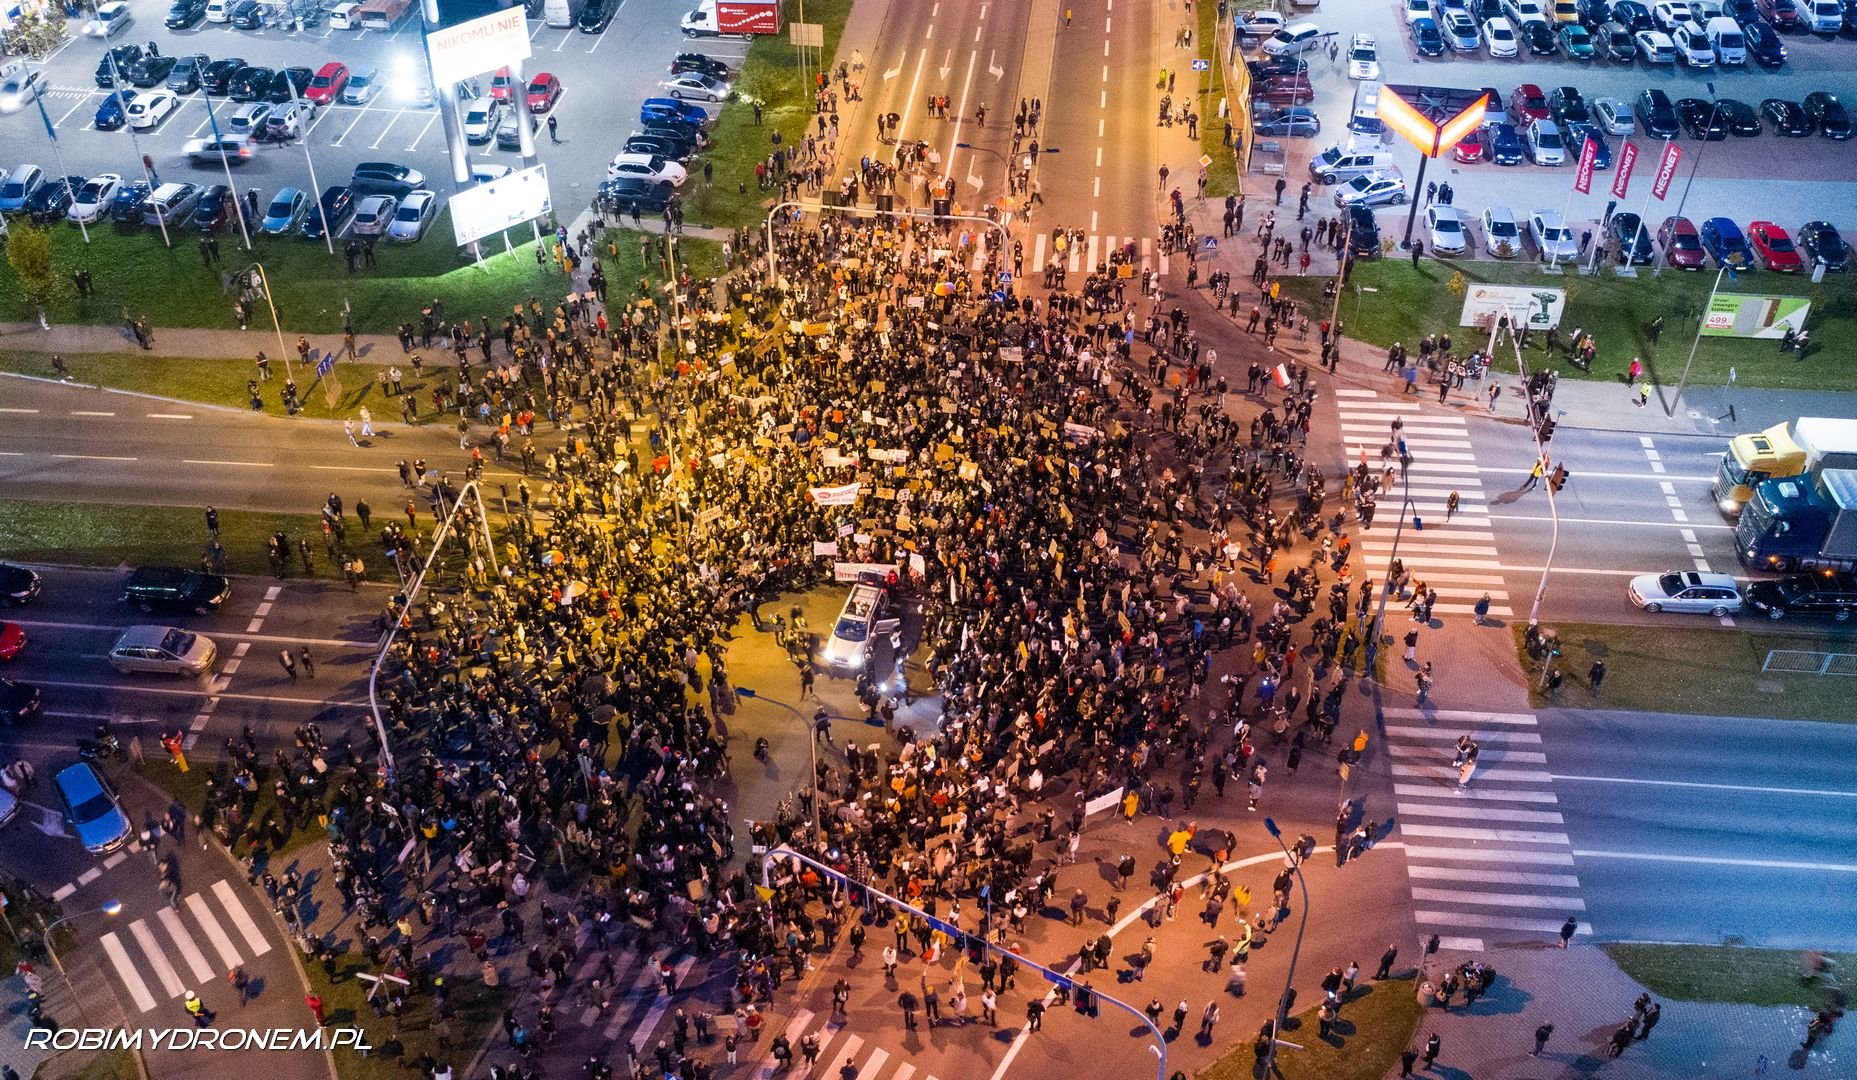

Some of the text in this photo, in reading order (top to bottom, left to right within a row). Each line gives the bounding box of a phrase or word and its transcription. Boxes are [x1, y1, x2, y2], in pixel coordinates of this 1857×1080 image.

[437, 16, 520, 50] NIKOMU NIE
[1578, 143, 1594, 190] NEONET
[1615, 146, 1635, 194] NEONET
[1655, 147, 1678, 195] NEONET
